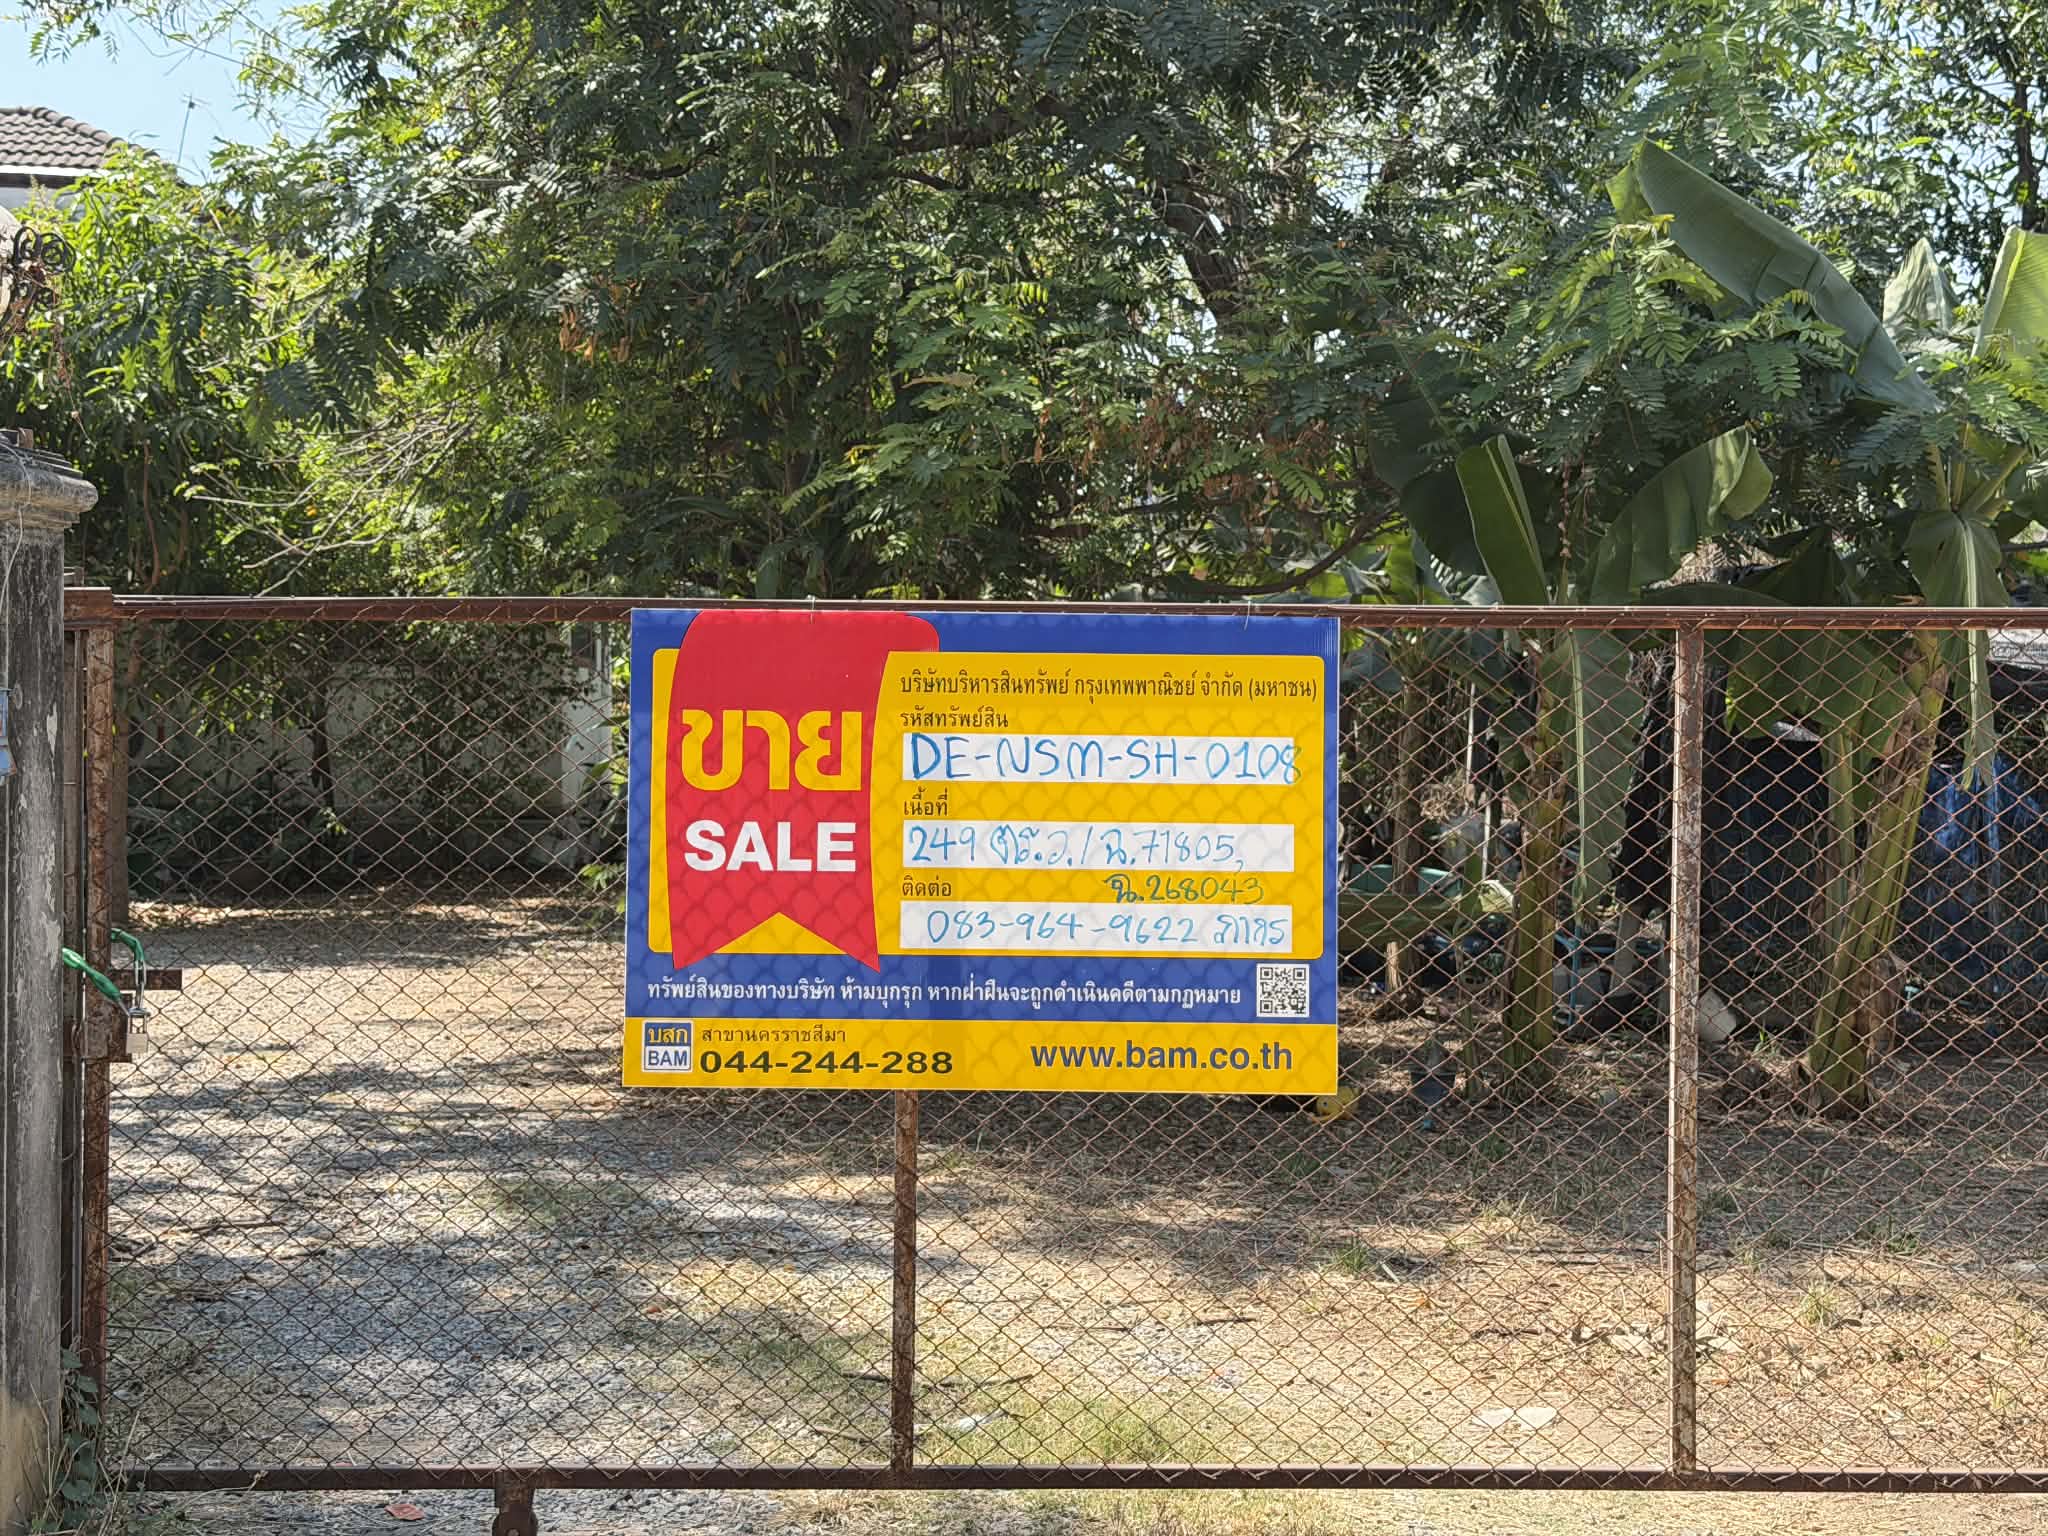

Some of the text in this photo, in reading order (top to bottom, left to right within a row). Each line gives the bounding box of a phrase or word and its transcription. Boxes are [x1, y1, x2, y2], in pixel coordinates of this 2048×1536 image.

[900, 668, 1318, 704] บริษัทบริหารสินทรัพย์ กรุงเทพพาณิชย์ จำกัด (มหาชน)
[900, 705, 1009, 728] รหัสทรัพย์สิน
[681, 708, 863, 792] ขาย
[903, 787, 949, 816] เนื้อที่
[684, 819, 857, 872] SALE
[908, 825, 977, 862] 249
[902, 875, 953, 897] ติดต่อ
[647, 973, 836, 1000] ทรัพย์สินของทางบริษัท
[840, 976, 923, 1009] ห้ามบุกรุก
[647, 1025, 688, 1044] บสก
[701, 1024, 847, 1043] สาขานครราชสีมา
[648, 1050, 688, 1066] BAM
[699, 1050, 954, 1075] 044-244-288
[1030, 1039, 1293, 1070] www.bam.co.th
